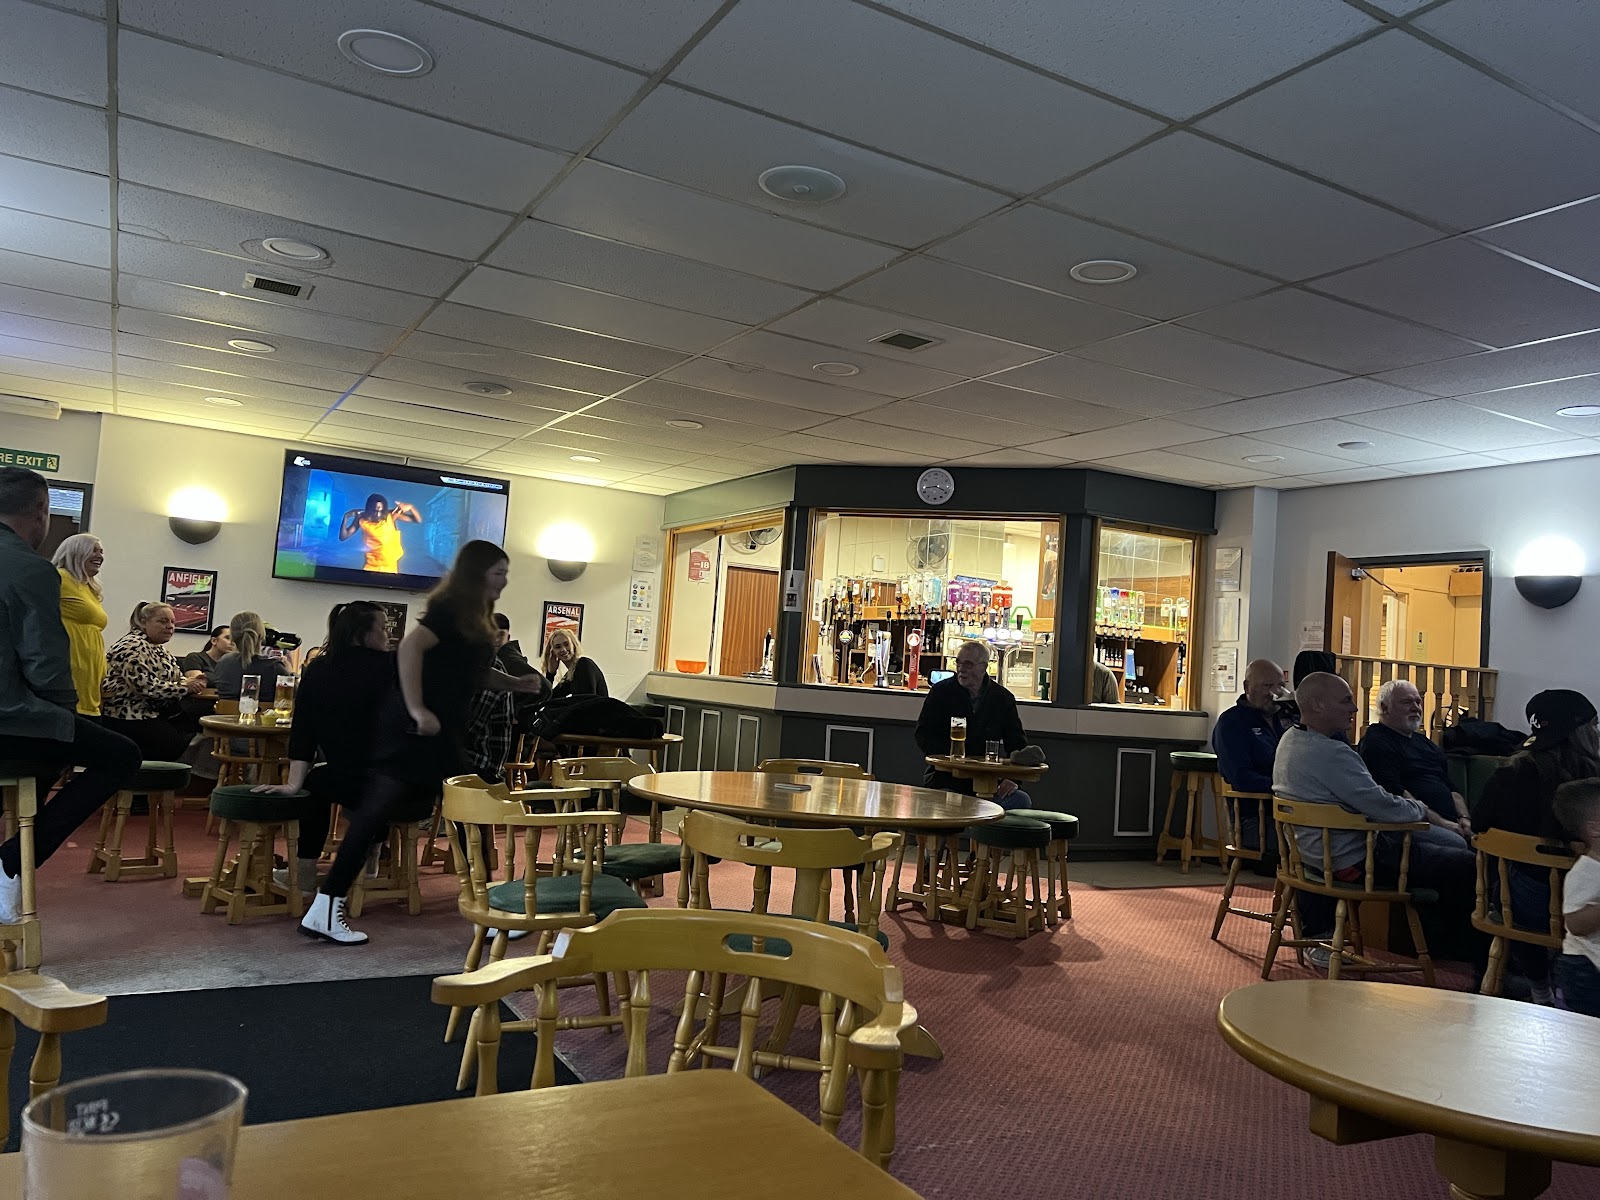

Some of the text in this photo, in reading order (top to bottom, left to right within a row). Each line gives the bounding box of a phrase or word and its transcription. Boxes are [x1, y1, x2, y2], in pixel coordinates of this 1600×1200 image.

[16, 454, 44, 467] EXIT
[700, 561, 710, 569] 18
[168, 572, 211, 585] ANFIELD
[547, 605, 580, 616] ARSENAL
